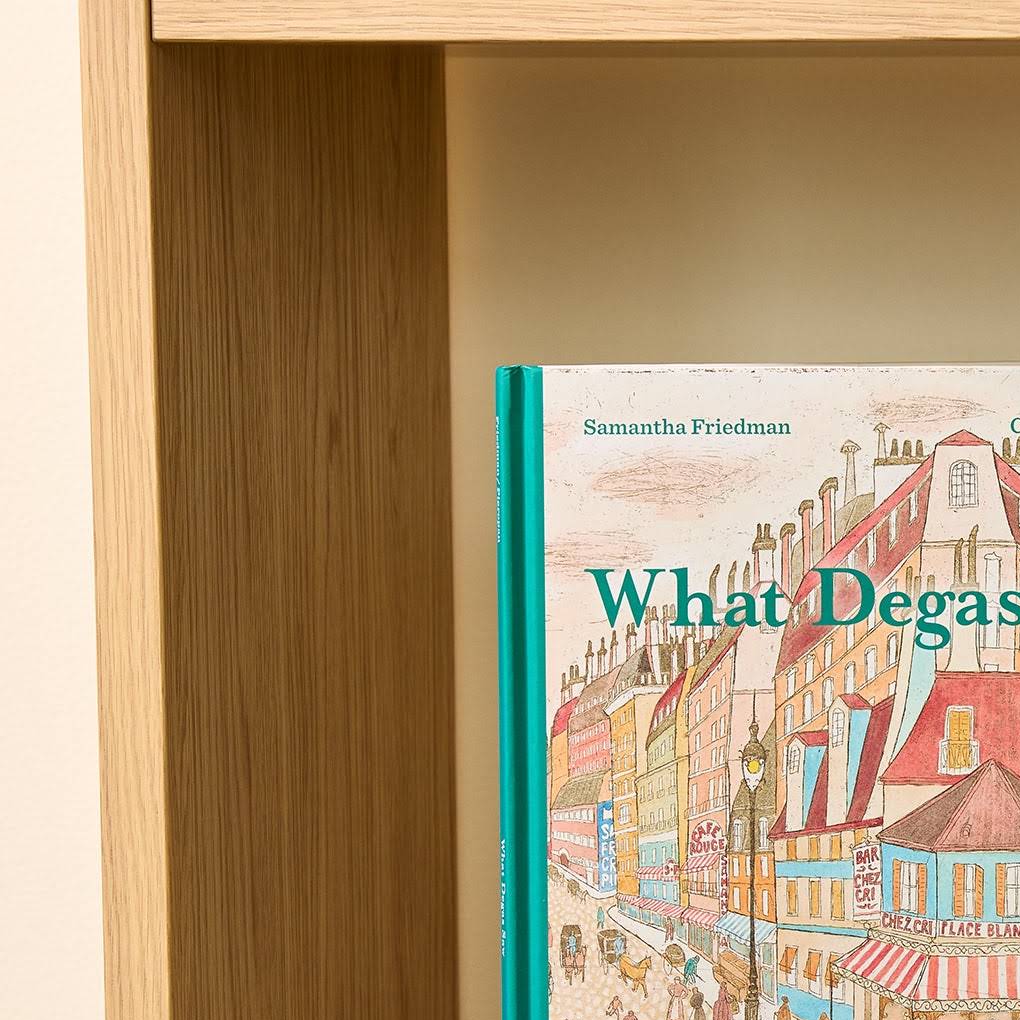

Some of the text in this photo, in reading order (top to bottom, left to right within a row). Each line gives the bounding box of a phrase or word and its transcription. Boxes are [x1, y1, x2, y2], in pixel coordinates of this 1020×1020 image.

[584, 419, 791, 435] Samantha Friedman
[585, 568, 788, 627] What
[856, 847, 879, 864] BAR
[854, 872, 880, 888] CHEZ
[855, 887, 875, 902] CRI
[942, 921, 981, 936] PLACE
